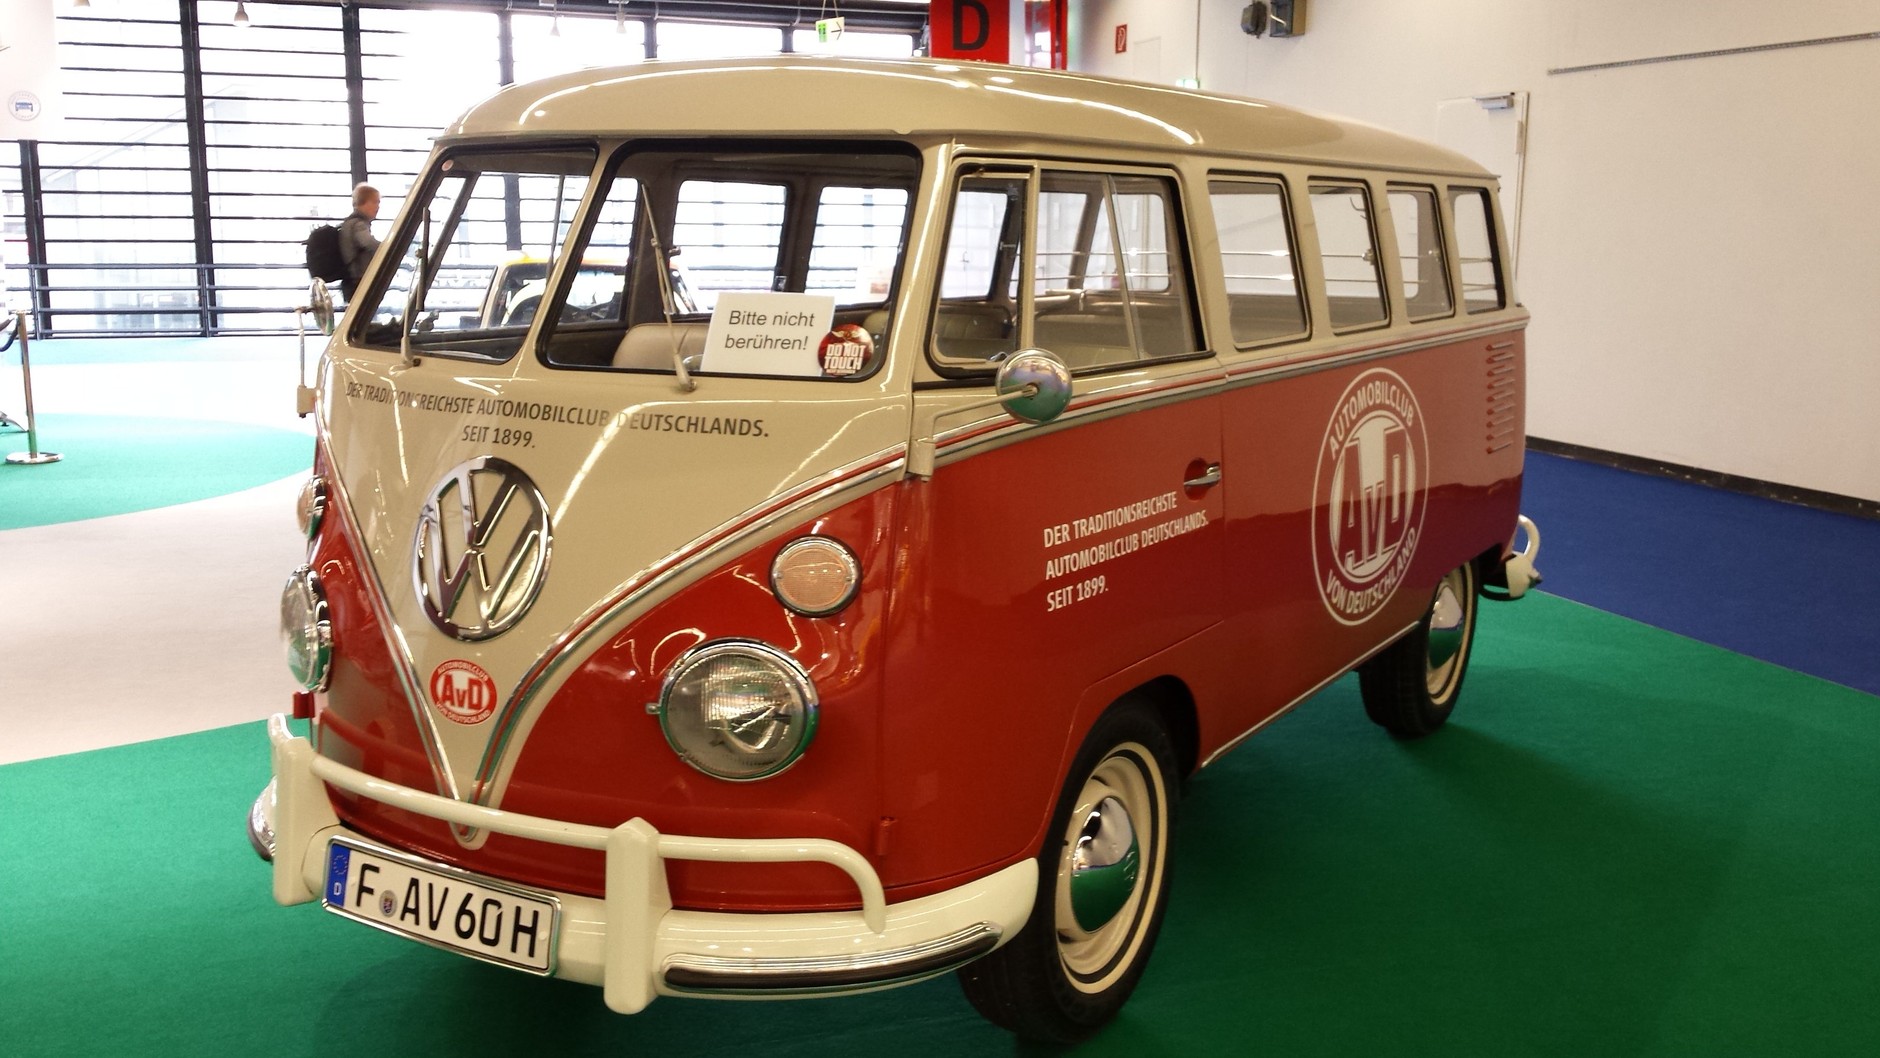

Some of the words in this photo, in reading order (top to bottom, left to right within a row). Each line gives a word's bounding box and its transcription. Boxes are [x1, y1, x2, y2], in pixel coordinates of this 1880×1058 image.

[953, 0, 989, 51] D
[728, 310, 767, 326] Bitte
[772, 311, 815, 327] nicht
[724, 334, 809, 351] berühren!
[826, 343, 843, 357] DO
[843, 341, 866, 357] NOT
[824, 356, 863, 370] TOUCH
[461, 424, 490, 443] SEIT
[491, 427, 536, 449] 1899.
[476, 398, 610, 427] AUTOMOBILCLUB
[616, 411, 770, 438] DEUTSCHLANDS.
[1329, 380, 1414, 461] AUTOMOBILCLUB
[1043, 524, 1071, 548] DER
[1072, 491, 1178, 540] TRADITIONSREICHSTE
[1045, 533, 1140, 580] AUTOMOBILCLUB
[1141, 509, 1209, 549] DEUTSCHLANDS.
[1326, 569, 1348, 610] VON
[1345, 527, 1415, 614] DEUTSCHLAND
[1046, 585, 1073, 612] SEIT
[1076, 574, 1109, 602] 1899.
[333, 882, 342, 896] D
[356, 863, 380, 907] F
